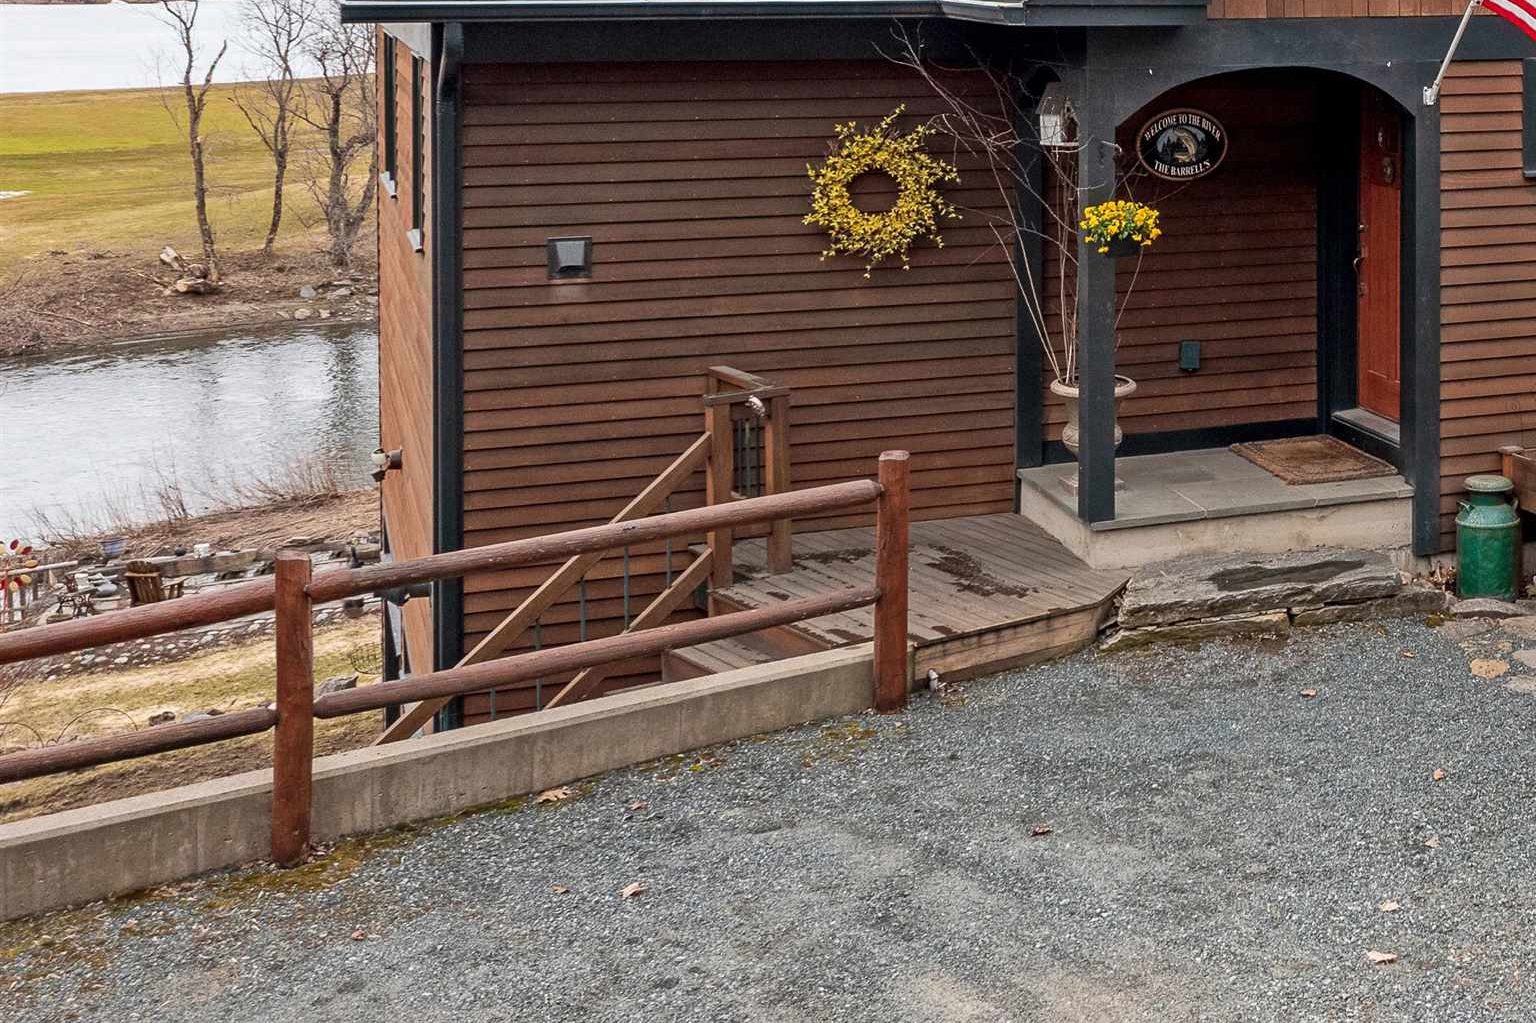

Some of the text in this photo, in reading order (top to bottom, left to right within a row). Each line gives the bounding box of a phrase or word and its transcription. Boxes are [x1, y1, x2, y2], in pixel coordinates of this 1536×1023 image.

[1144, 113, 1221, 142] WELCOME TO THE RIVER
[1154, 159, 1169, 175] THE
